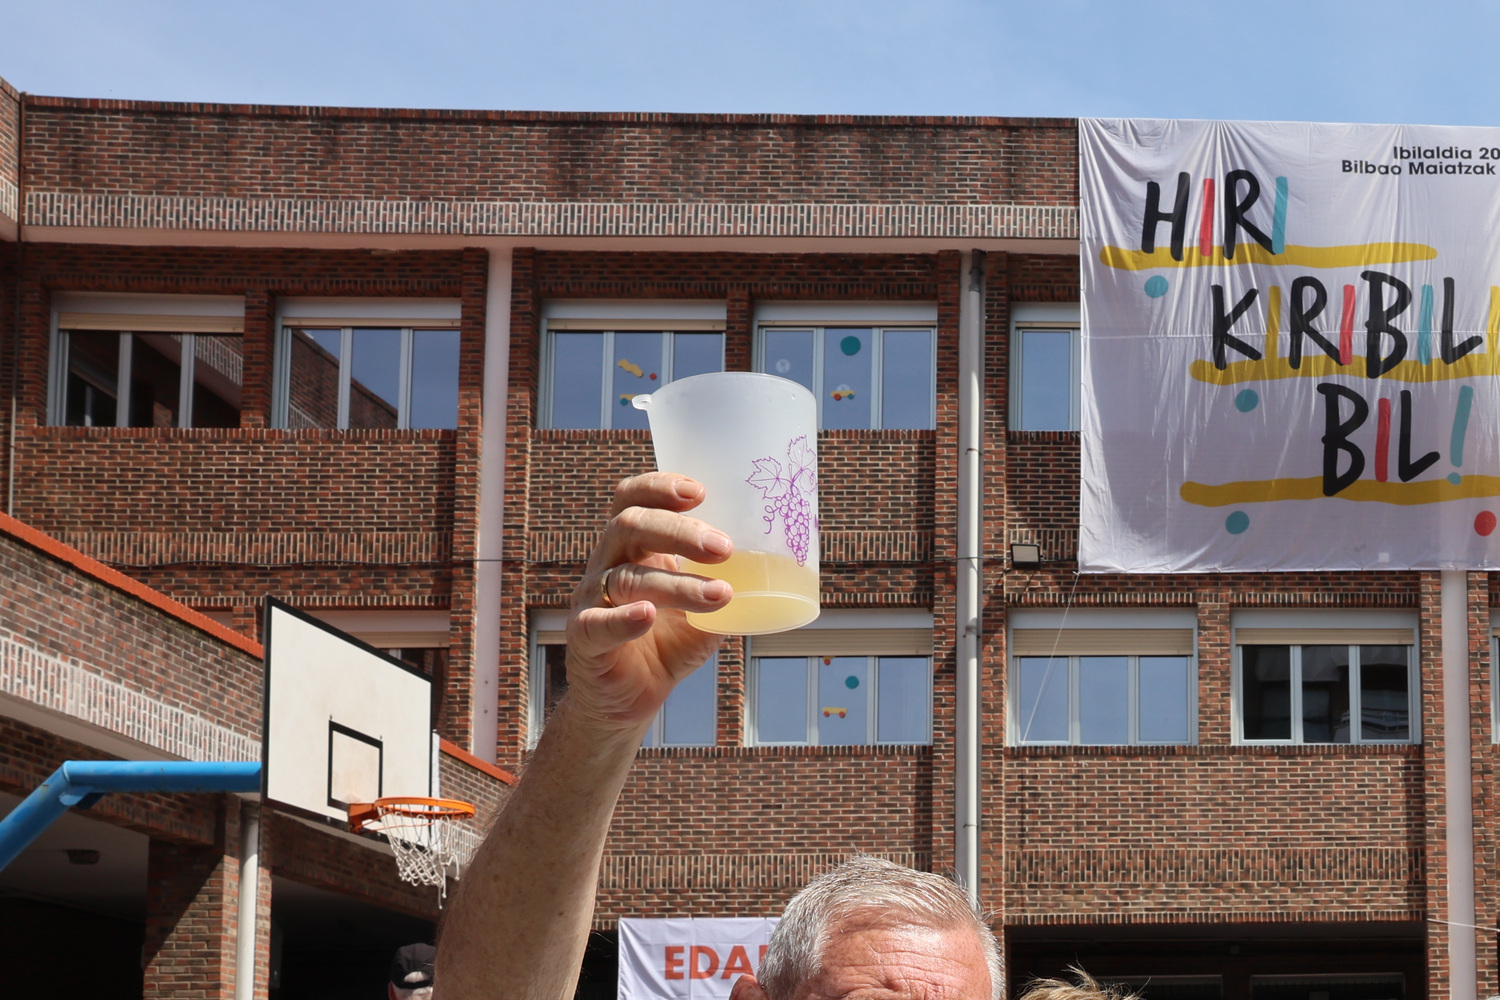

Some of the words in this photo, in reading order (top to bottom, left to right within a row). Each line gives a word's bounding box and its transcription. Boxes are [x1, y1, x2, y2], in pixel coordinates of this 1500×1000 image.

[1342, 160, 1402, 176] Bilbao
[1409, 161, 1496, 176] Maiatzak
[1393, 146, 1472, 161] Ibilaldia
[1141, 169, 1288, 261] HIRI
[1317, 382, 1474, 496] BIL!
